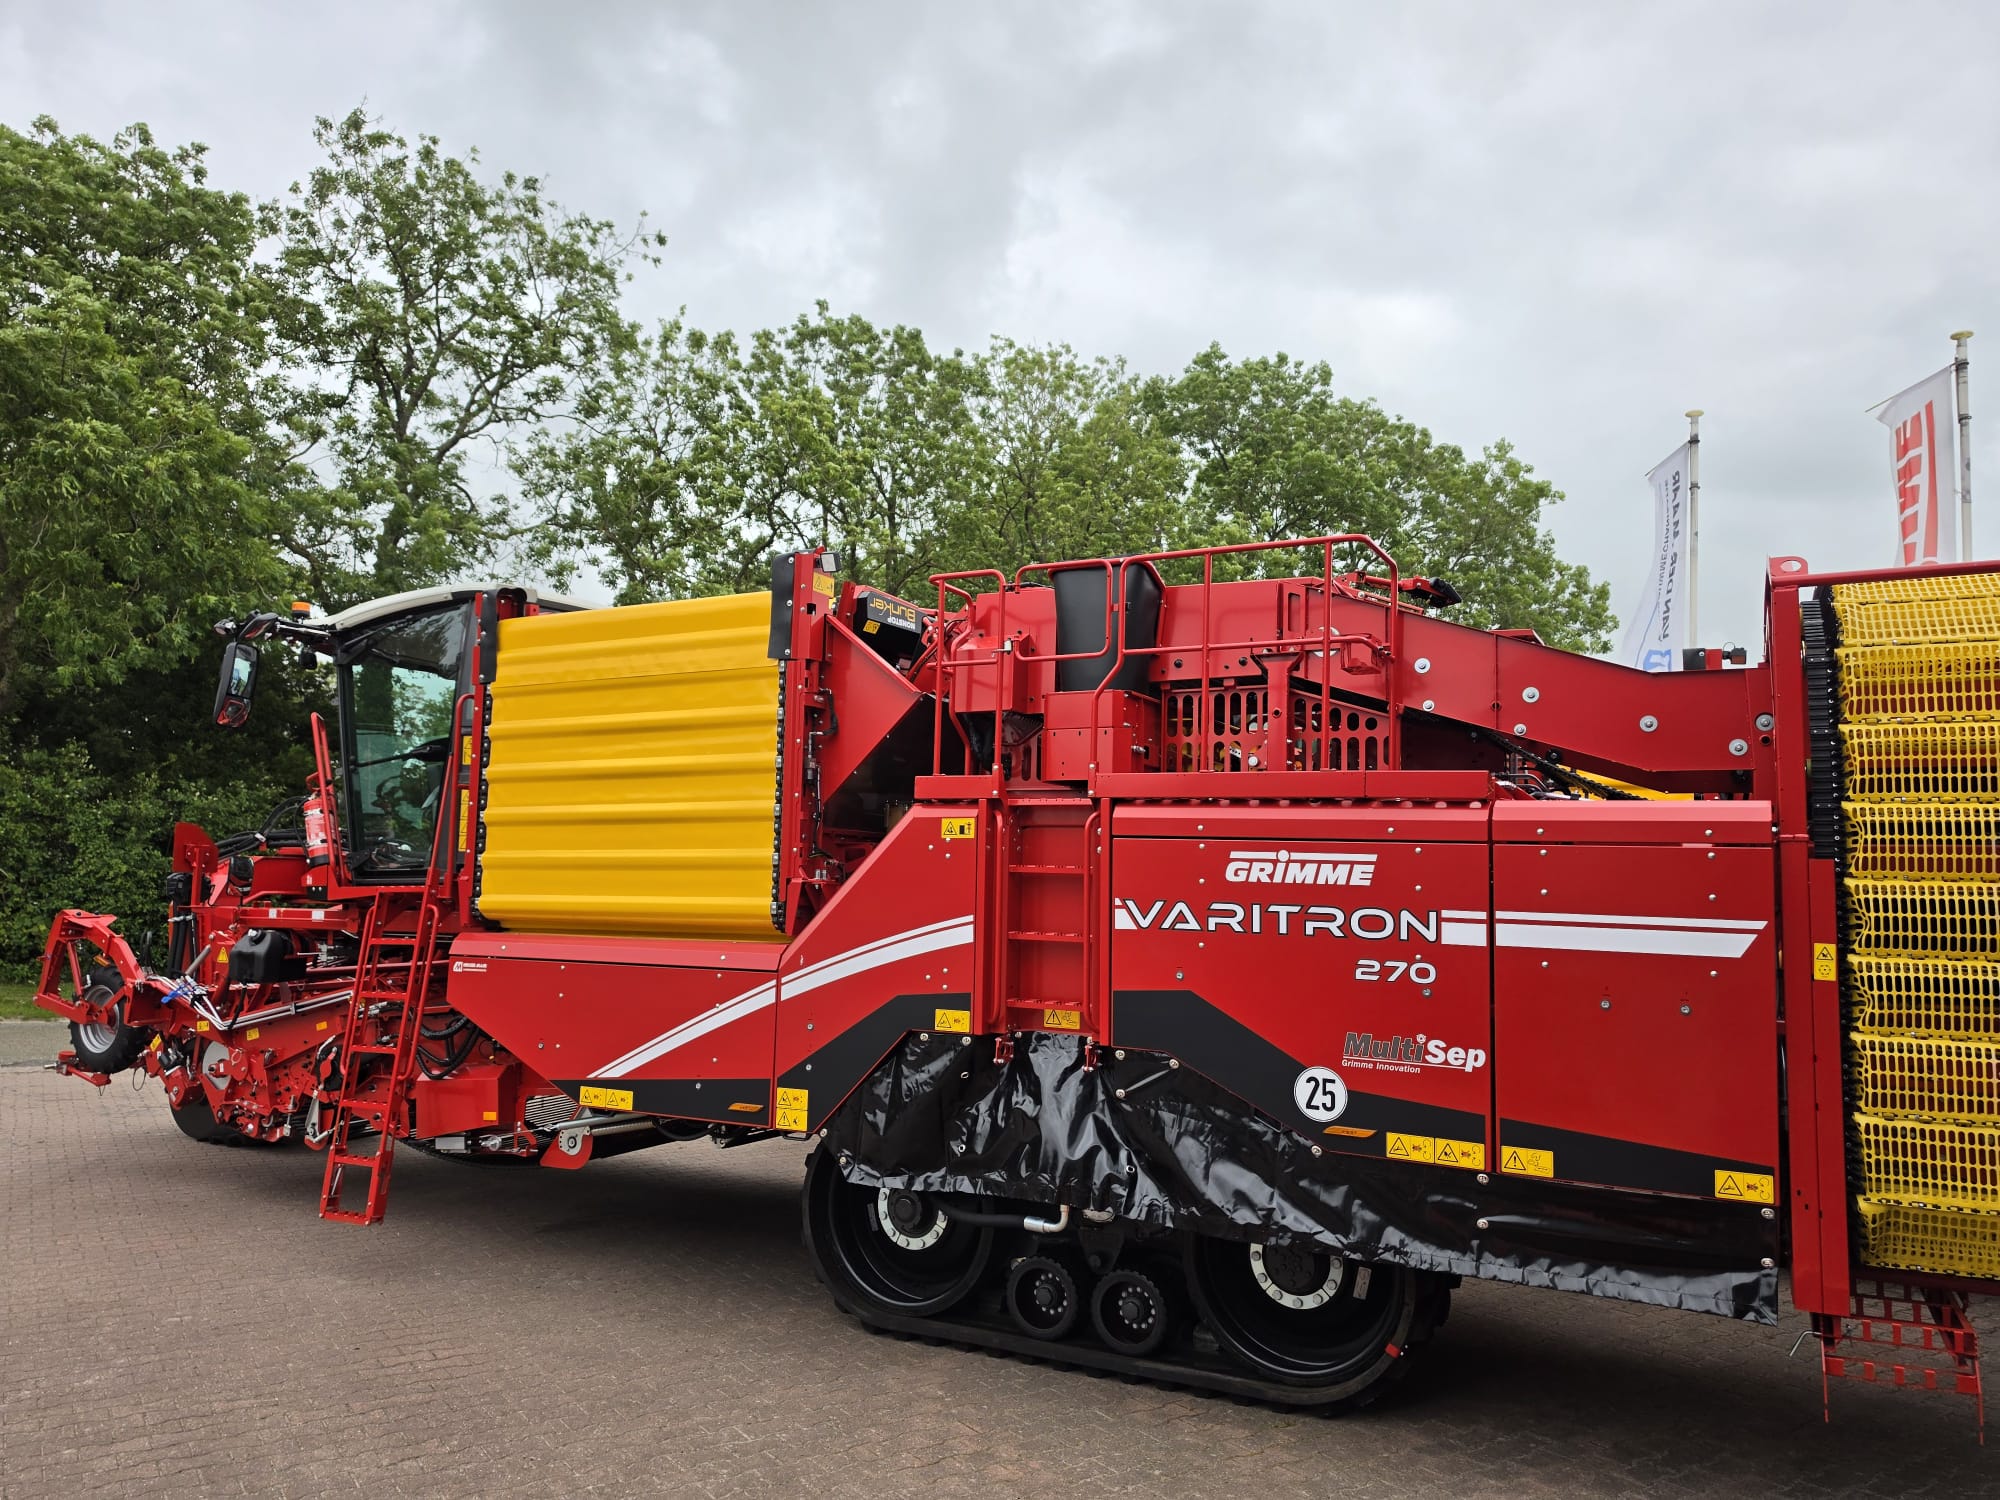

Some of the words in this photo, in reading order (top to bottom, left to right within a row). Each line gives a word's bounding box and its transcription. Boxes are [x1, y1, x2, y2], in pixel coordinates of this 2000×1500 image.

[870, 597, 916, 623] Bunker
[887, 616, 916, 630] NONSTOP
[1225, 850, 1376, 887] GRIMME
[1124, 899, 1439, 943] VARITRON
[1354, 959, 1437, 985] 270
[1341, 1060, 1374, 1069] Grimme
[1376, 1062, 1421, 1074] Innovation
[1305, 1076, 1336, 1112] 25
